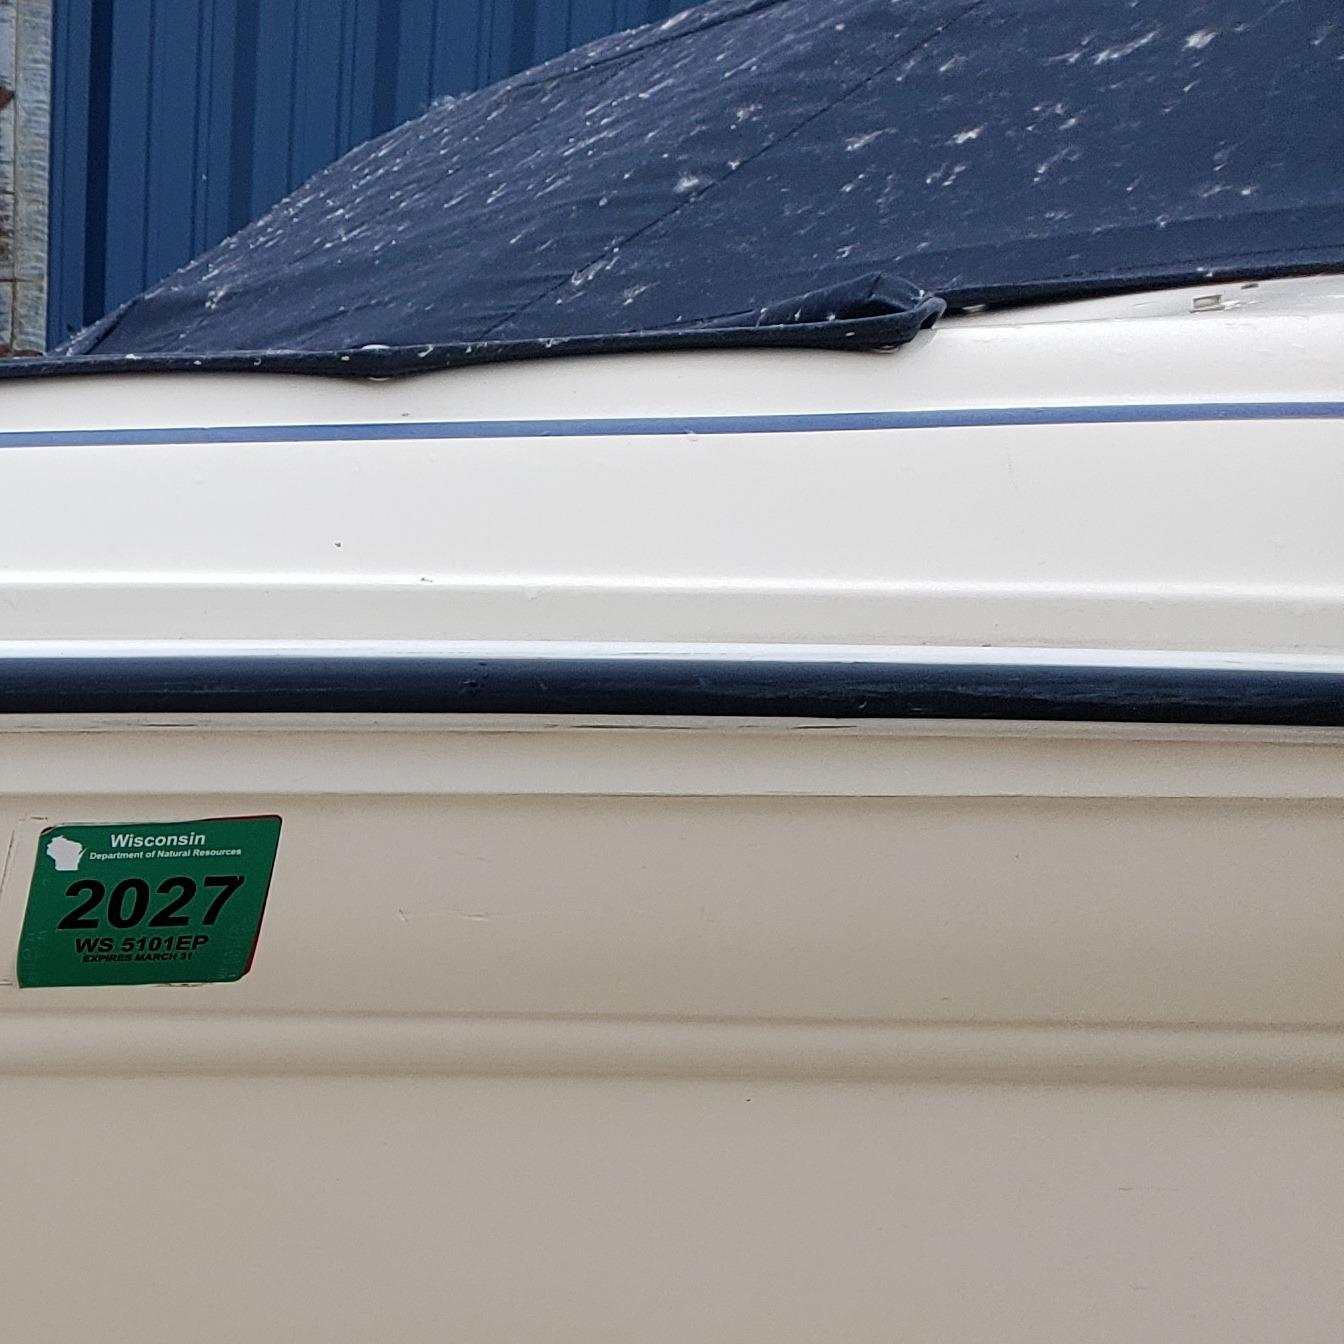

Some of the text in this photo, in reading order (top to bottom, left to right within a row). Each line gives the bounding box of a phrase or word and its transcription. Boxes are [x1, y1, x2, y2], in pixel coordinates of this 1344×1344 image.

[110, 831, 206, 848] Wisconsin
[89, 848, 242, 861] Department of Natural Resources
[57, 876, 245, 930] 2027
[75, 935, 209, 952] WS 5101EP
[82, 951, 193, 963] EXPIRES MARCH 31
